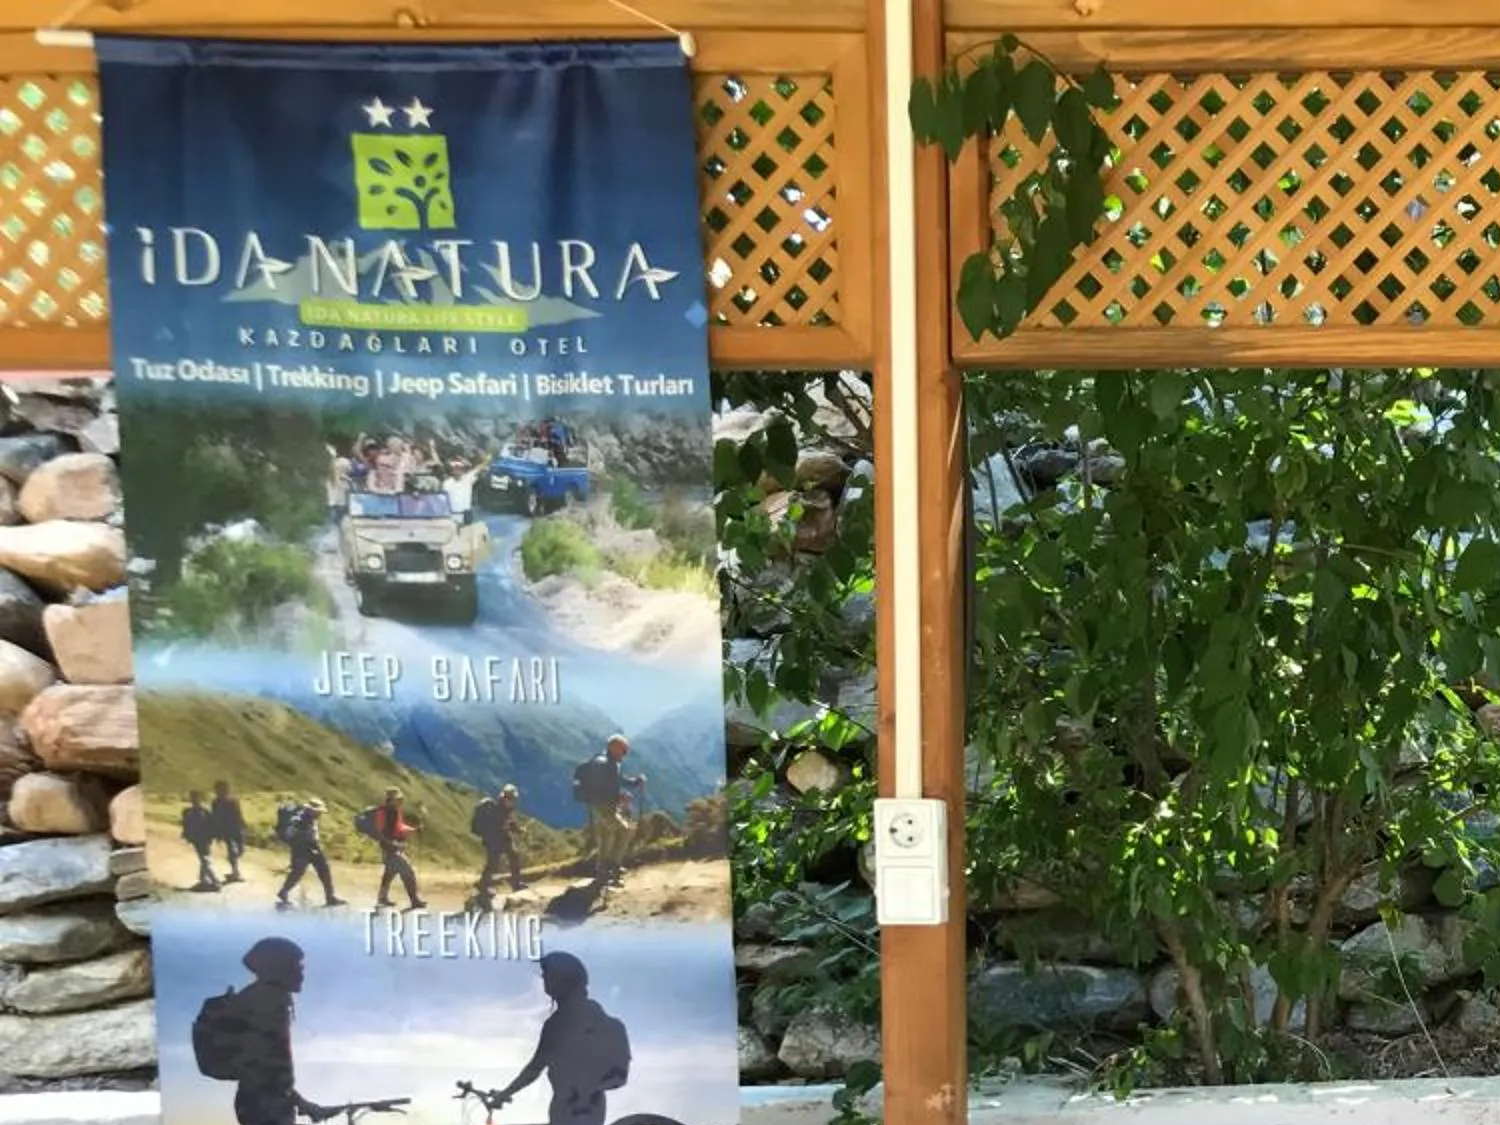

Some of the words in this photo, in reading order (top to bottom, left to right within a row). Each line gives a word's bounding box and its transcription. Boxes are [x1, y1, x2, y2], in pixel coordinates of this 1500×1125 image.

[511, 336, 588, 357] OTEL
[129, 357, 174, 381] Tuz
[177, 359, 249, 385] Odası
[265, 364, 369, 397] Trekking
[388, 372, 444, 400] Jeep
[450, 372, 517, 396] Safari
[535, 373, 614, 397] Bisiklet
[313, 650, 402, 701] JEEP
[431, 655, 562, 704] SAFARI
[362, 908, 544, 963] TREEKING
